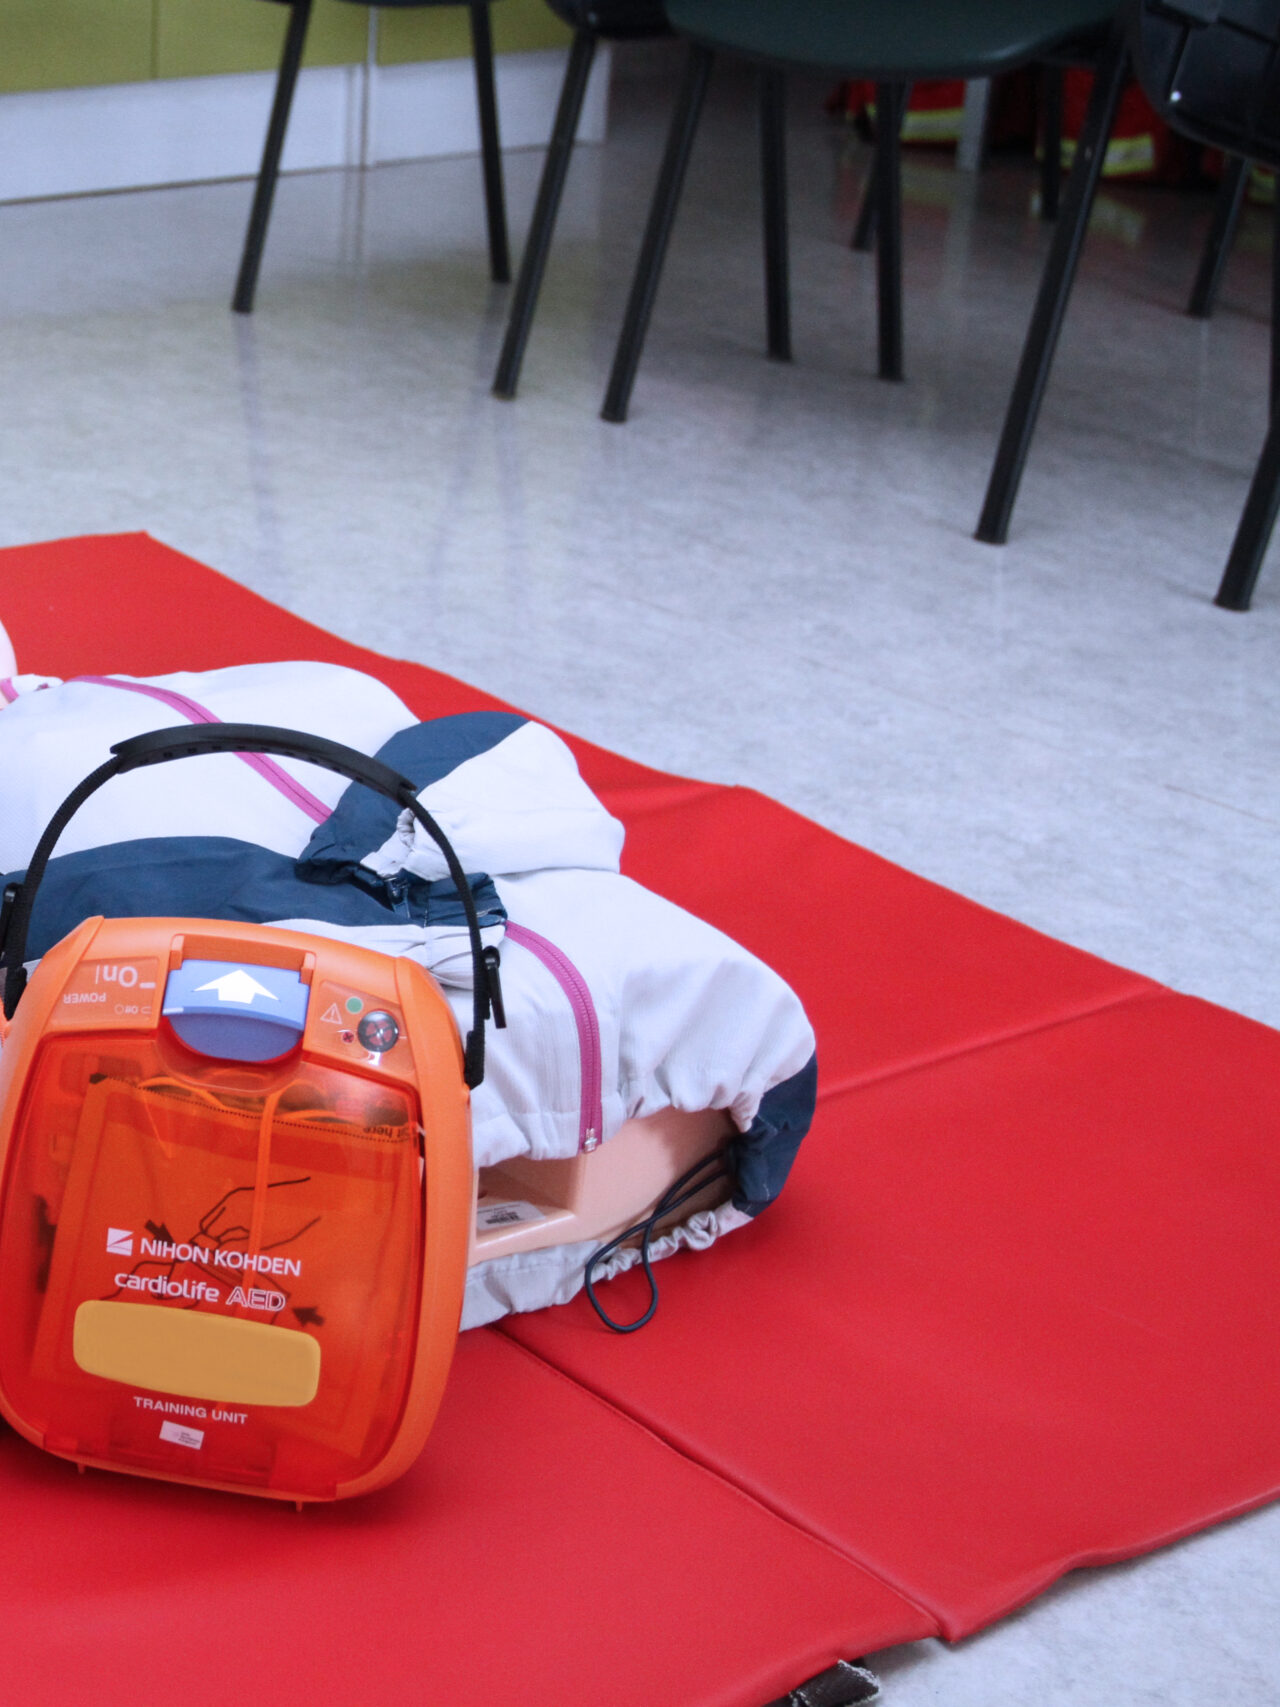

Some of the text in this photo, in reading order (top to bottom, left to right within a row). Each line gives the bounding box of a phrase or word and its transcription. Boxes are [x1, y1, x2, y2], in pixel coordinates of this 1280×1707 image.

[103, 965, 138, 987] On
[63, 992, 106, 1004] POWER
[140, 1238, 301, 1276] NIHON KOHDEN
[114, 1272, 286, 1312] cardiolife AED
[133, 1396, 248, 1424] TRAINING UNIT
